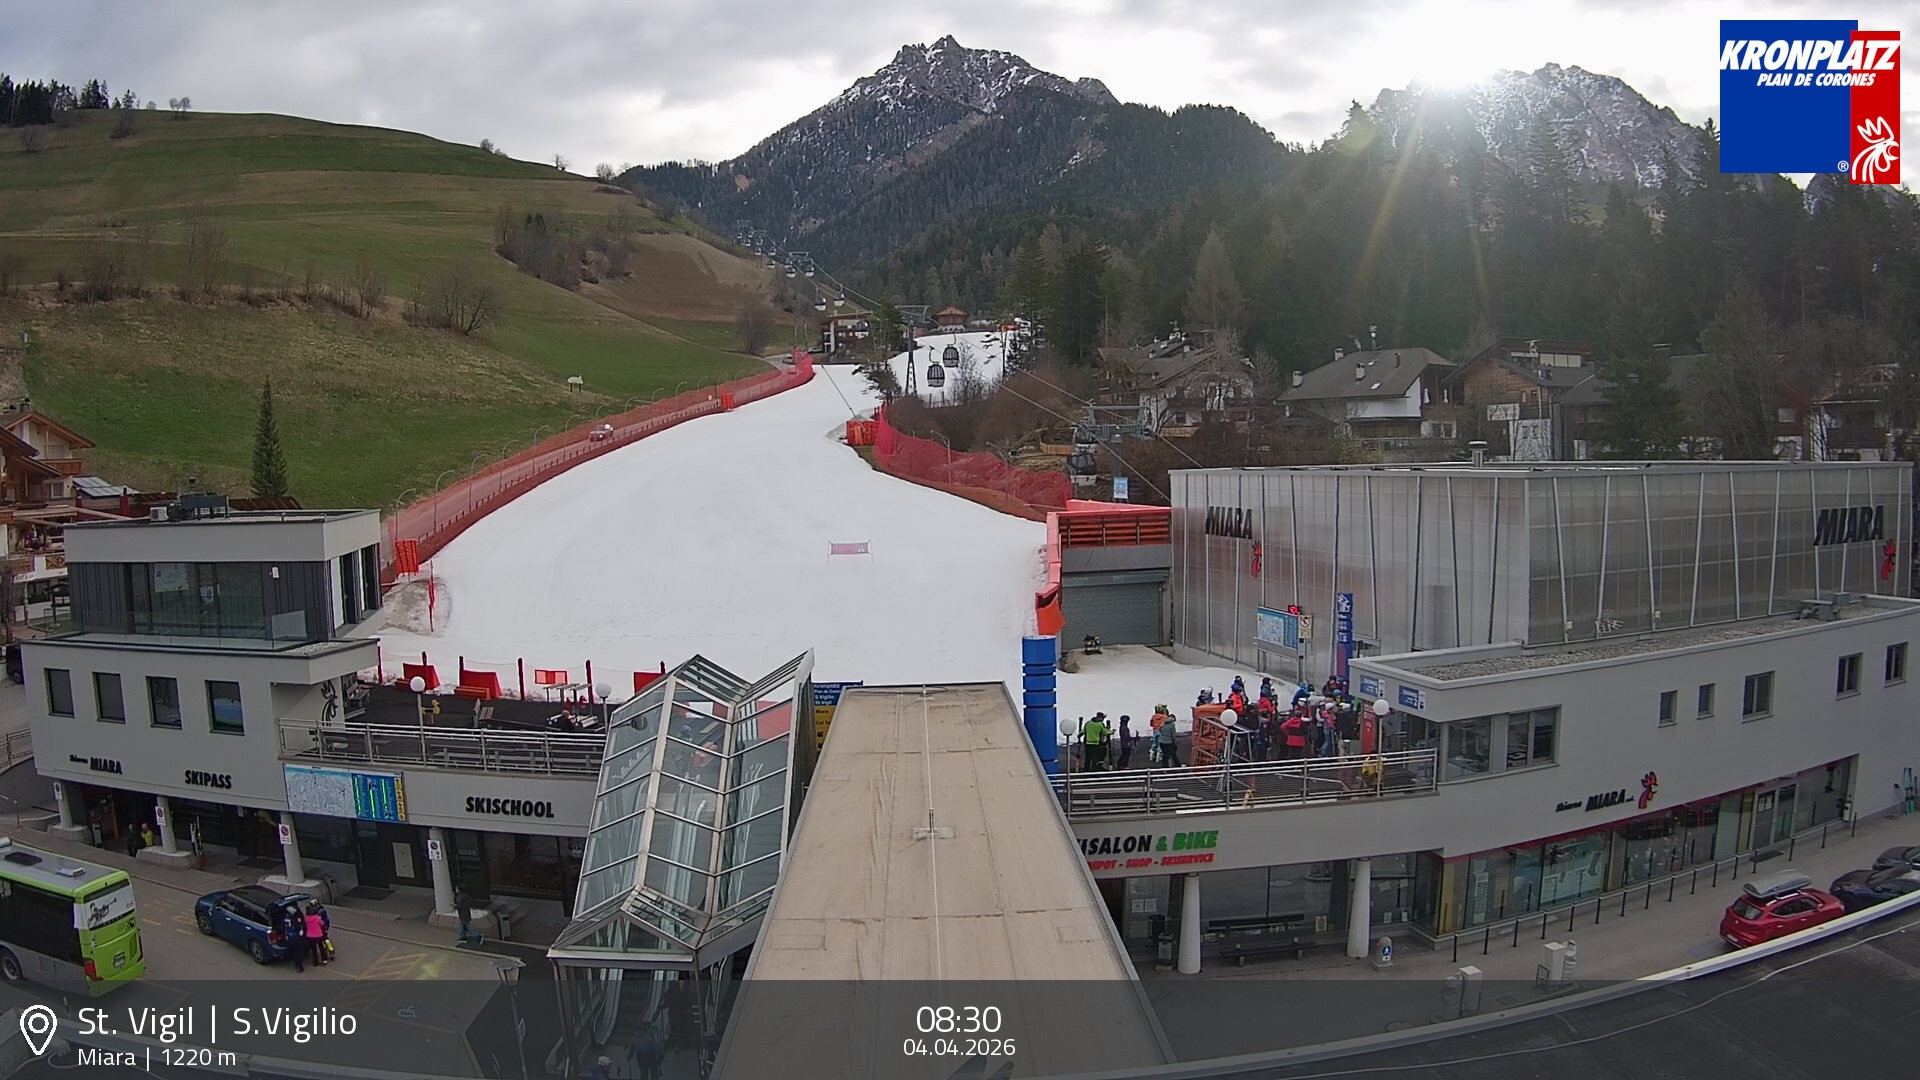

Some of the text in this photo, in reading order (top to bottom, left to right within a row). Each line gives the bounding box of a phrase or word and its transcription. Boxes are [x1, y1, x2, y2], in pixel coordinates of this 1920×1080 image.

[1205, 505, 1252, 539] MIARA
[1814, 505, 1883, 546] MIARA
[90, 757, 122, 775] MIARA
[185, 769, 232, 790] SKIPASS
[465, 796, 555, 819] SKISCHOOL
[1585, 789, 1626, 812] MIARA
[1155, 836, 1168, 852] &
[1173, 830, 1219, 851] BIKE
